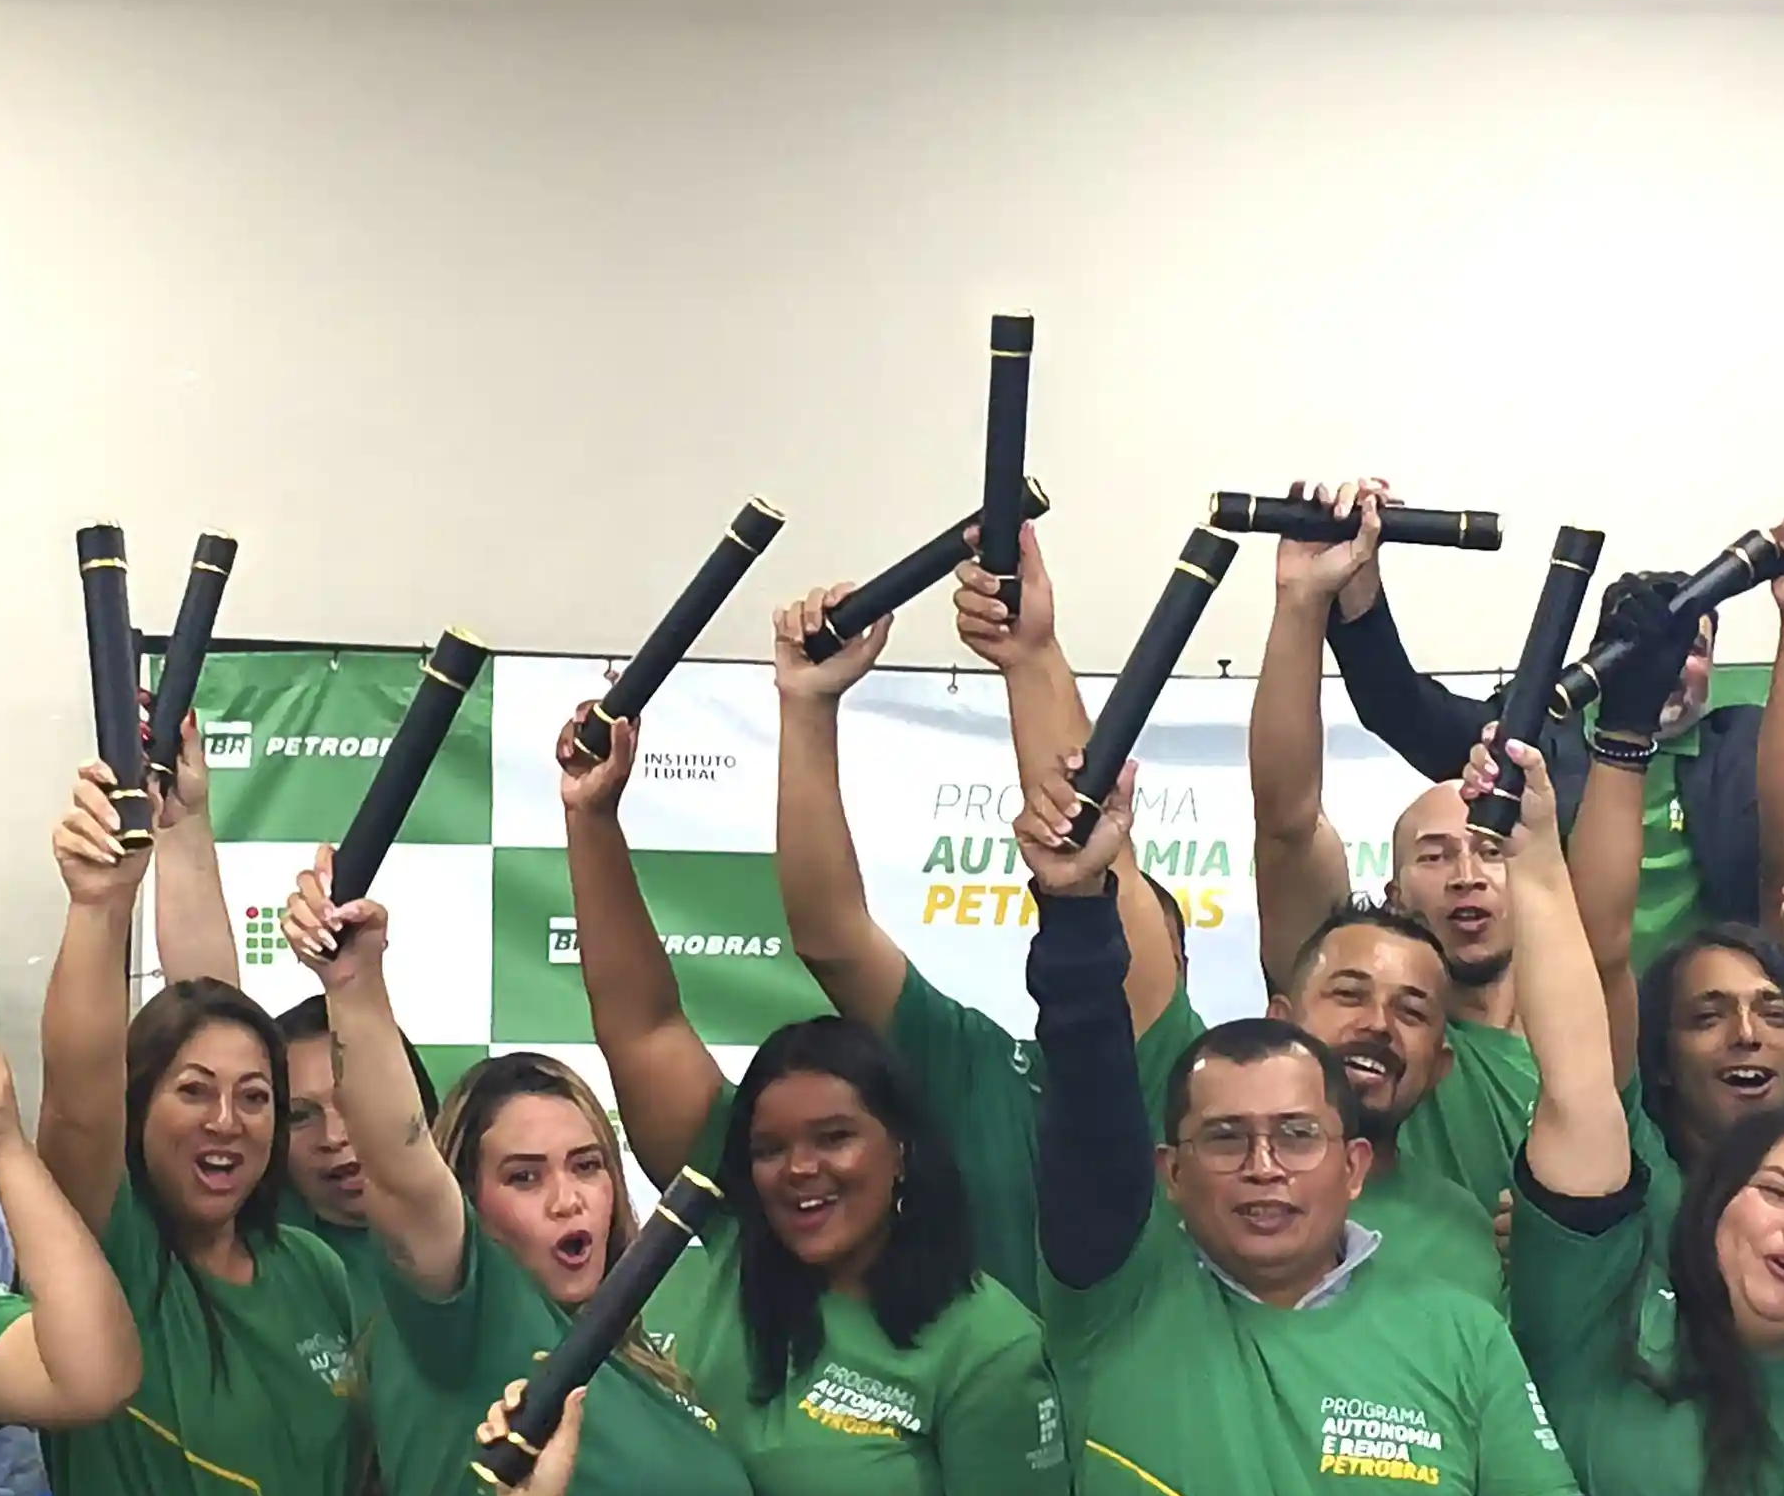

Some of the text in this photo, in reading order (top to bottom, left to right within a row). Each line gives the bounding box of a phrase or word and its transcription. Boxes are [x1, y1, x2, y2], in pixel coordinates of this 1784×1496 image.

[266, 736, 394, 757] PETROB
[645, 753, 736, 769] INSTITUTO
[644, 766, 718, 782] FEDERAL
[932, 783, 1200, 824] PROMA
[922, 836, 1231, 876] AUTMIA
[658, 935, 783, 956] ROBRAS
[823, 1362, 916, 1410] PROGRAMA
[813, 1378, 922, 1433] AUTONOMIA
[1320, 1397, 1427, 1428] PROGRAMA
[1321, 1417, 1443, 1451] AUTONOMIA
[1322, 1435, 1411, 1462] E RENDA
[1319, 1454, 1440, 1486] PETROBRAS
